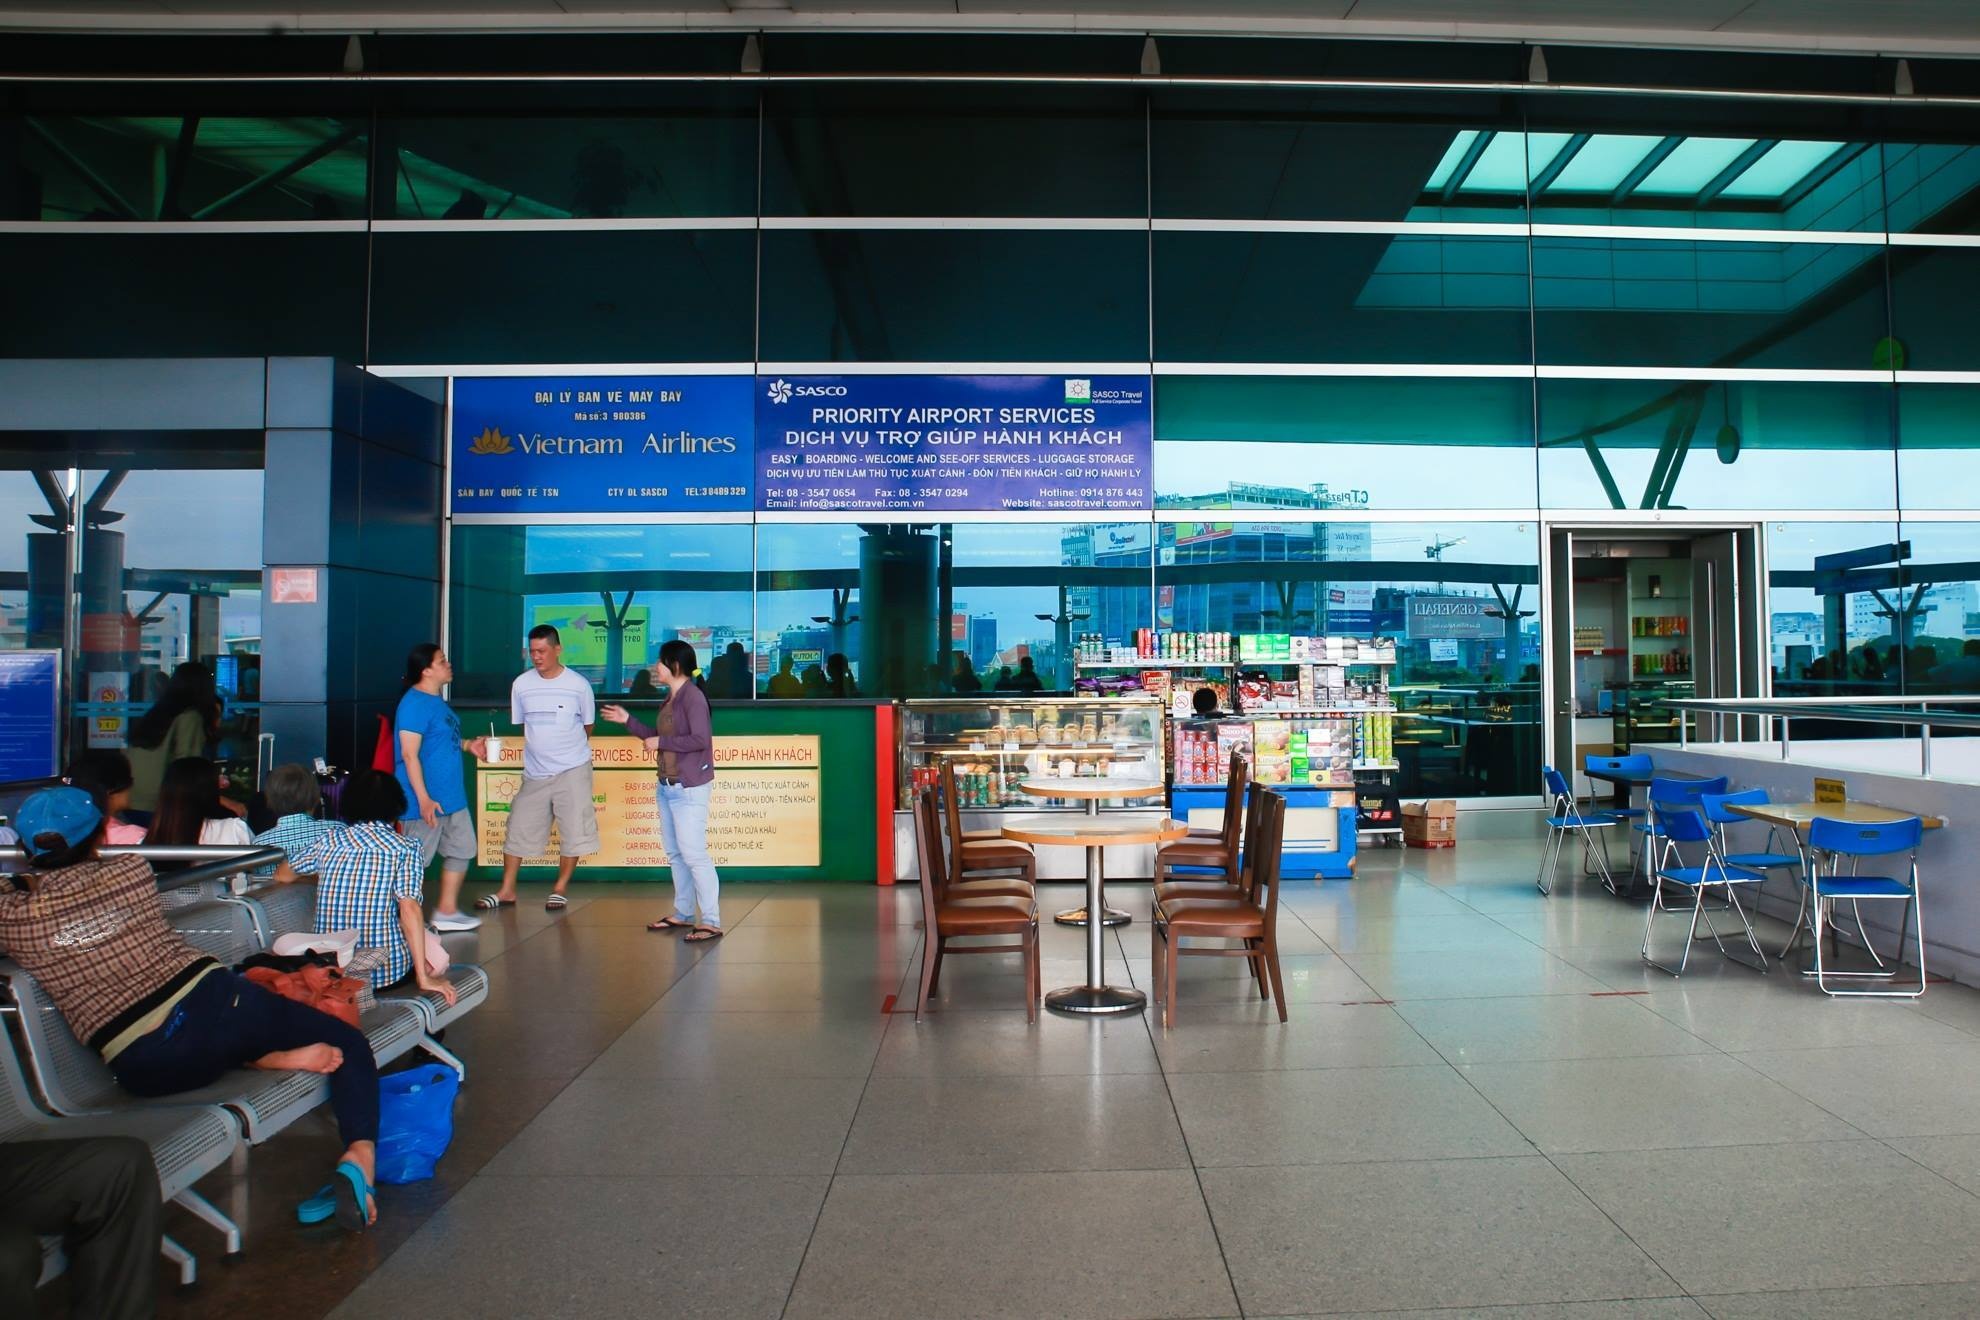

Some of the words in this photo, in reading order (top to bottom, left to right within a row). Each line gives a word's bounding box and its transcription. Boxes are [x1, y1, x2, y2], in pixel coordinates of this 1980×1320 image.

[795, 386, 847, 396] SASCO
[1092, 390, 1120, 399] SASCO
[1121, 390, 1143, 399] Travel
[660, 391, 682, 402] BAY
[613, 412, 646, 421] 980386
[812, 408, 903, 424] PRIORITY
[906, 408, 994, 424] AIRPORT
[1000, 408, 1095, 424] SERVICES
[786, 431, 835, 448] DỊCH
[841, 431, 869, 448] VỤ
[876, 431, 922, 448] TRỢ
[927, 427, 977, 445] GIÚP
[983, 428, 1042, 445] HÀNH
[1049, 427, 1122, 445] KHÁCH
[518, 433, 623, 455] Vietnam
[642, 431, 736, 453] Airlines
[771, 454, 798, 464] EASY
[806, 454, 857, 464] BOARDING
[865, 454, 914, 464] WELCOME
[916, 454, 937, 464] AND
[939, 454, 980, 464] SEE-OFF
[983, 454, 1030, 464] SERVICES
[1038, 454, 1086, 464] LUGGAGE
[1088, 454, 1135, 464] STORAGE
[767, 469, 789, 480] DỊCH
[792, 469, 804, 480] VỤ
[890, 469, 909, 480] TỤC
[1024, 467, 1057, 478] KHÁCH
[479, 488, 494, 497] BAY
[543, 488, 559, 497] TSN
[608, 488, 624, 496] CTY
[628, 488, 638, 496] DL
[641, 488, 668, 496] SASCO
[766, 489, 784, 497] Tel:
[787, 489, 798, 497] 08
[808, 489, 830, 497] 3547
[833, 489, 856, 497] 0654
[875, 489, 896, 497] Fax:
[899, 489, 910, 497] 08
[920, 489, 942, 497] 3547
[945, 489, 968, 497] 0294
[1040, 488, 1078, 497] Hotline:
[1080, 489, 1103, 497] 0914
[1106, 489, 1123, 497] 876
[1126, 489, 1143, 497] 443
[766, 499, 797, 508] Email:
[800, 499, 924, 509] info@sascotravel.com.vn
[1002, 499, 1045, 508] Website:
[1048, 499, 1142, 508] sascotravel.com.vn
[714, 748, 739, 762] GIÚP
[742, 747, 771, 762] HÀNH
[774, 747, 812, 762] KHÁCH
[625, 797, 656, 805] WELCOME
[625, 812, 655, 820] LUGGAGE
[625, 827, 652, 835] LANDING
[626, 842, 639, 850] CAR
[640, 842, 662, 850] RENTAL
[755, 841, 763, 849] XE
[626, 857, 646, 865] SASCO
[648, 857, 670, 865] TRAVEL
